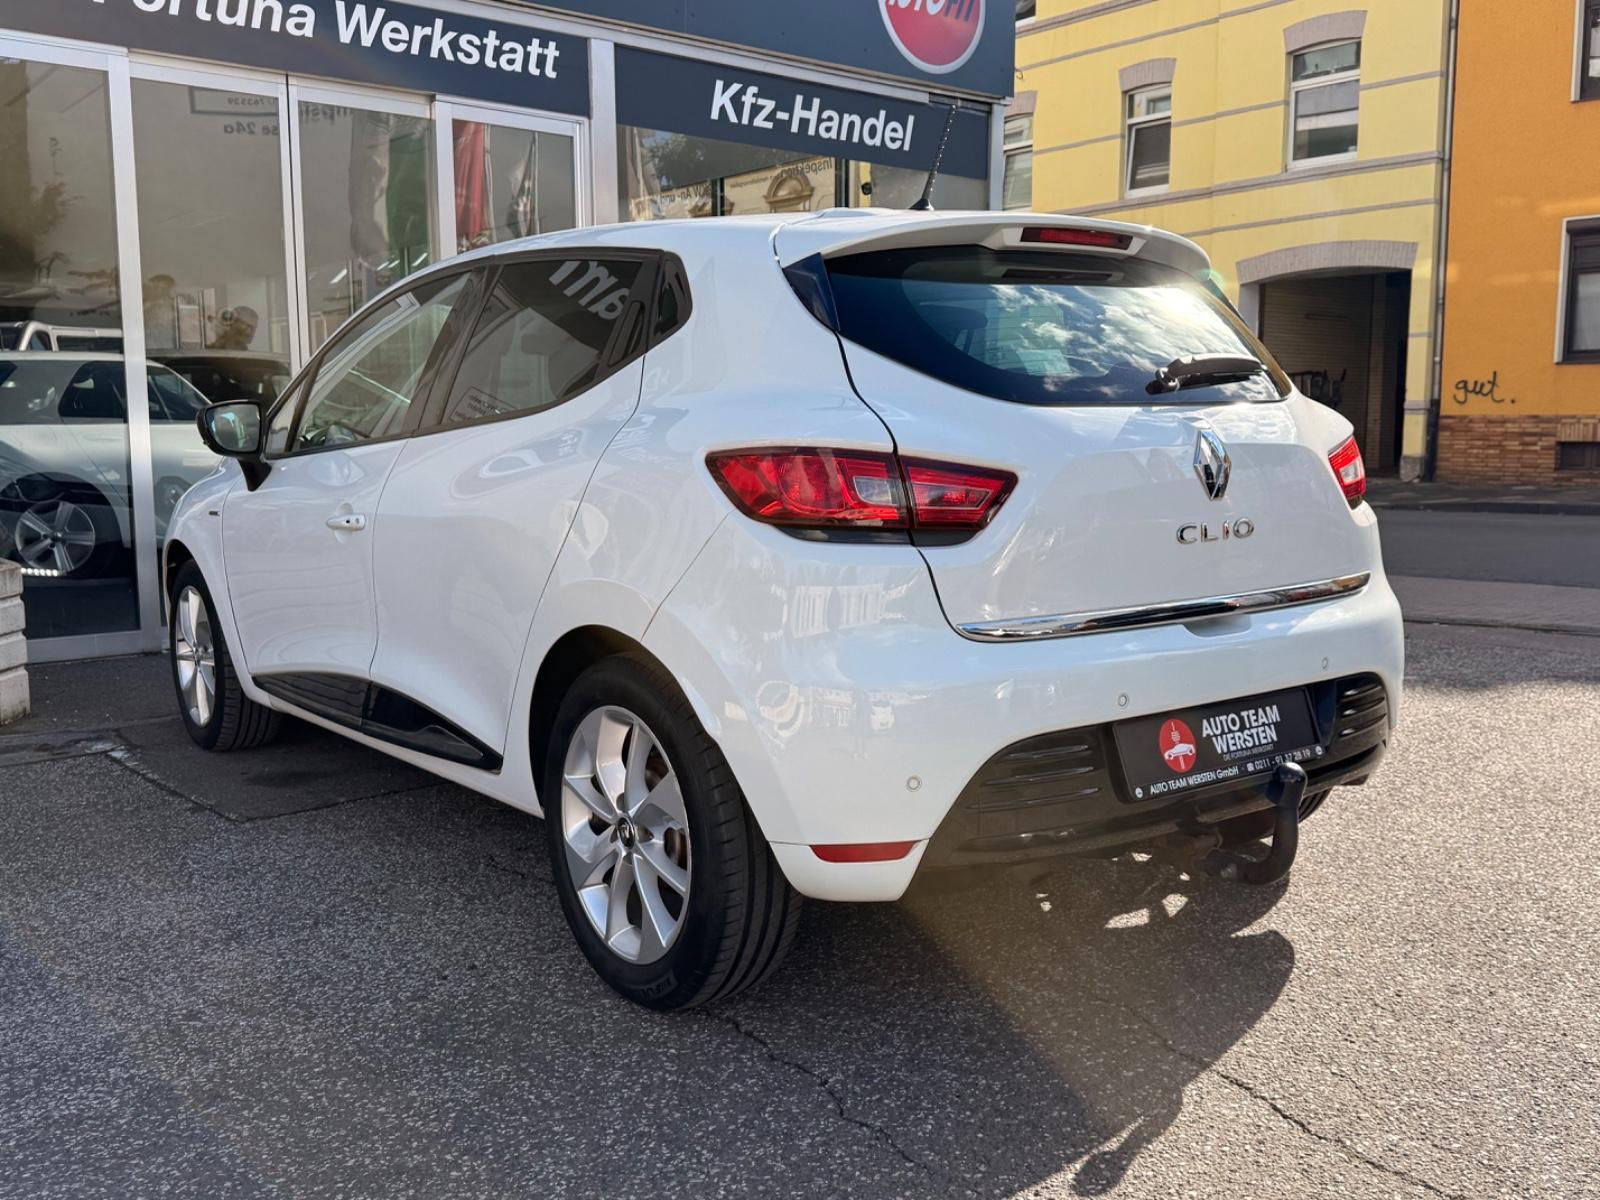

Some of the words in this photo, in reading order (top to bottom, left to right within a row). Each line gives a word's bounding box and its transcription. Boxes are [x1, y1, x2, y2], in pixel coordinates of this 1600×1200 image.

[335, 0, 560, 79] Werkstatt
[710, 79, 915, 151] Kfz-Handel
[1453, 371, 1517, 405] gut.
[1176, 518, 1254, 544] CLIO
[1202, 713, 1240, 737] AUTO
[1241, 705, 1281, 728] TEAM
[1212, 724, 1278, 754] WERSTEN
[1150, 782, 1168, 795] AUTO
[1168, 777, 1188, 790] TEAM
[1187, 771, 1216, 785] WERSTEN
[1216, 766, 1239, 779] GmbH
[1254, 758, 1271, 770] 0211
